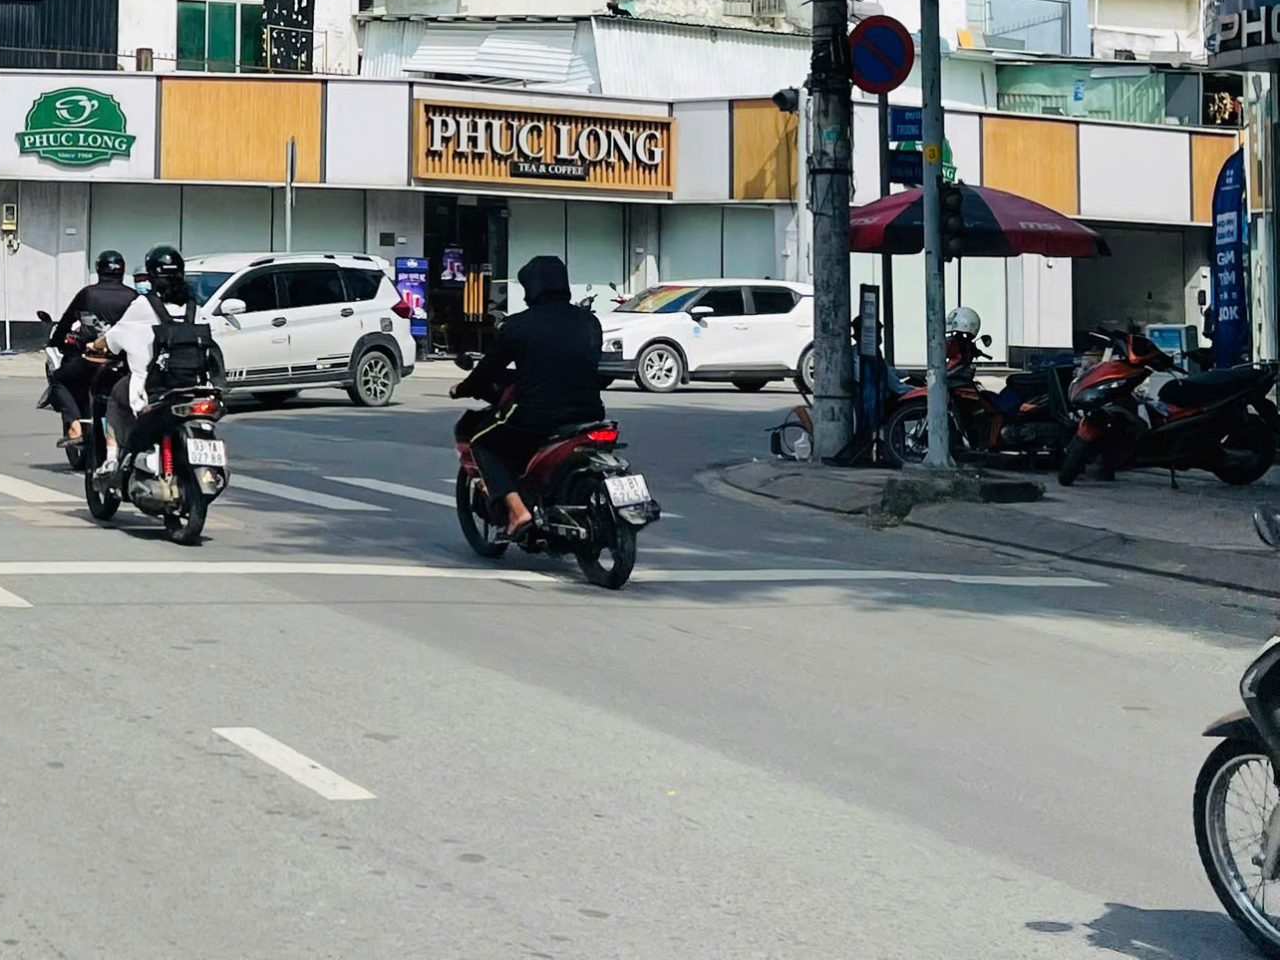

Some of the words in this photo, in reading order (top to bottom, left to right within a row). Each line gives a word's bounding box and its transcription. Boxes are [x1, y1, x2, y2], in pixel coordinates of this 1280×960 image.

[24, 132, 73, 148] PHUC
[78, 133, 127, 151] LONG
[429, 115, 545, 159] PHUC
[555, 124, 664, 165] LONG
[928, 149, 936, 159] 3
[518, 163, 536, 173] TEA
[538, 165, 546, 173] &
[548, 165, 584, 176] COFFEE
